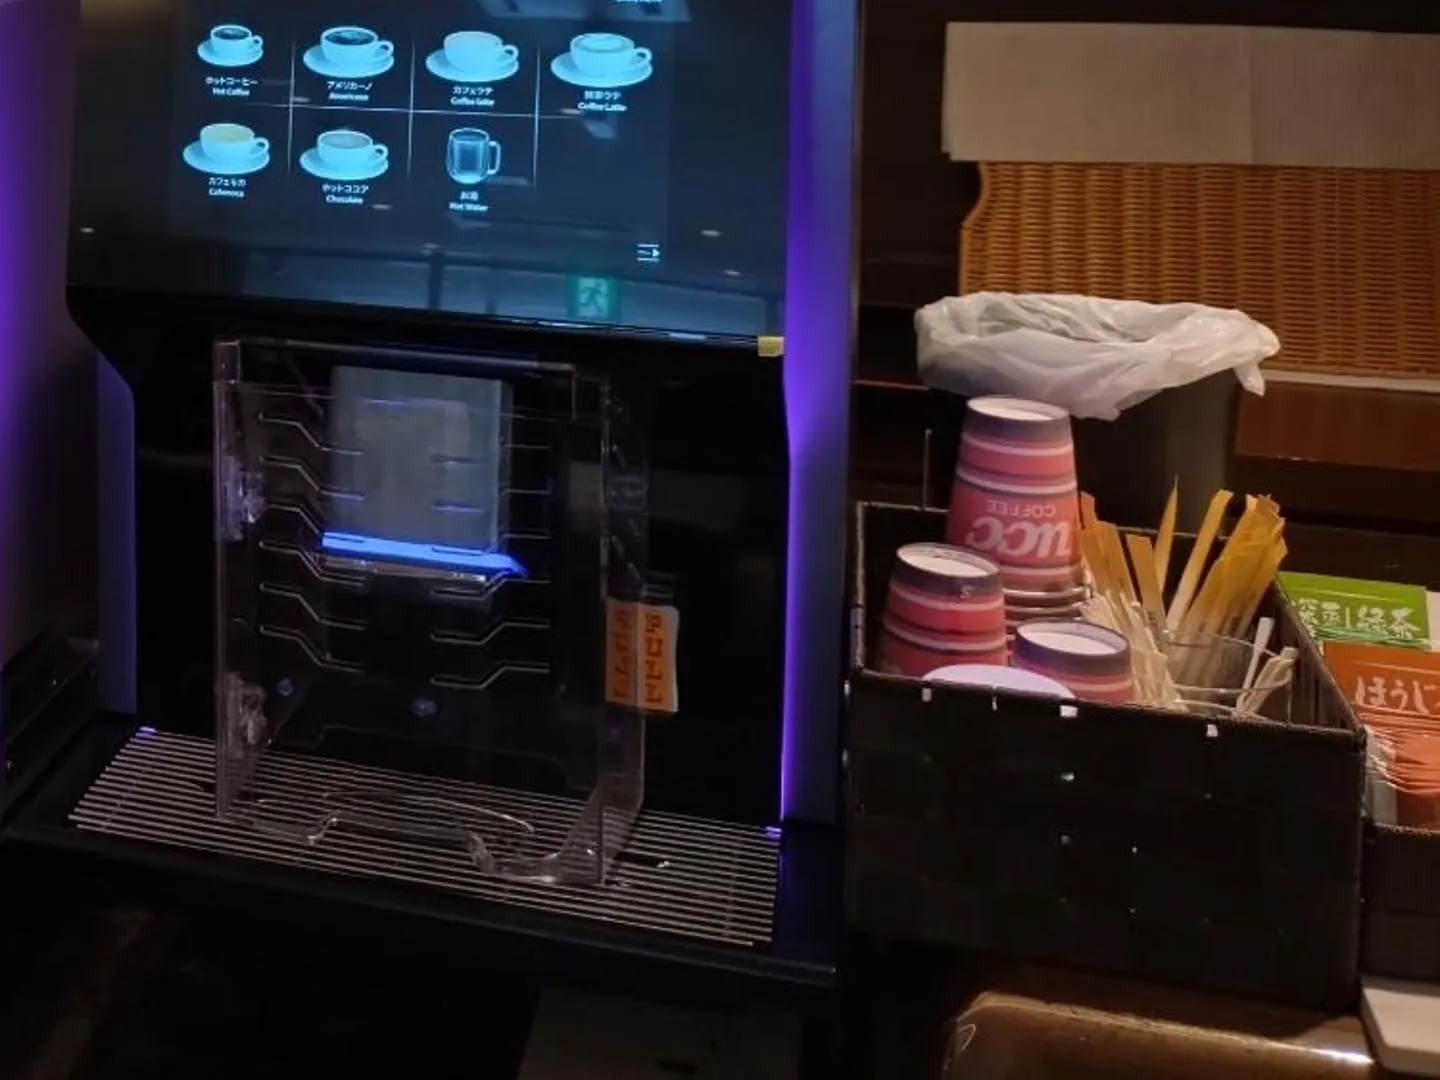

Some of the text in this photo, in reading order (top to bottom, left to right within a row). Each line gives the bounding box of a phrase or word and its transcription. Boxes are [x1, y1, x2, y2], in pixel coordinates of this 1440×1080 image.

[986, 499, 1057, 519] COFFEE
[644, 611, 664, 704] PULL
[1355, 676, 1440, 716] ほうじ
